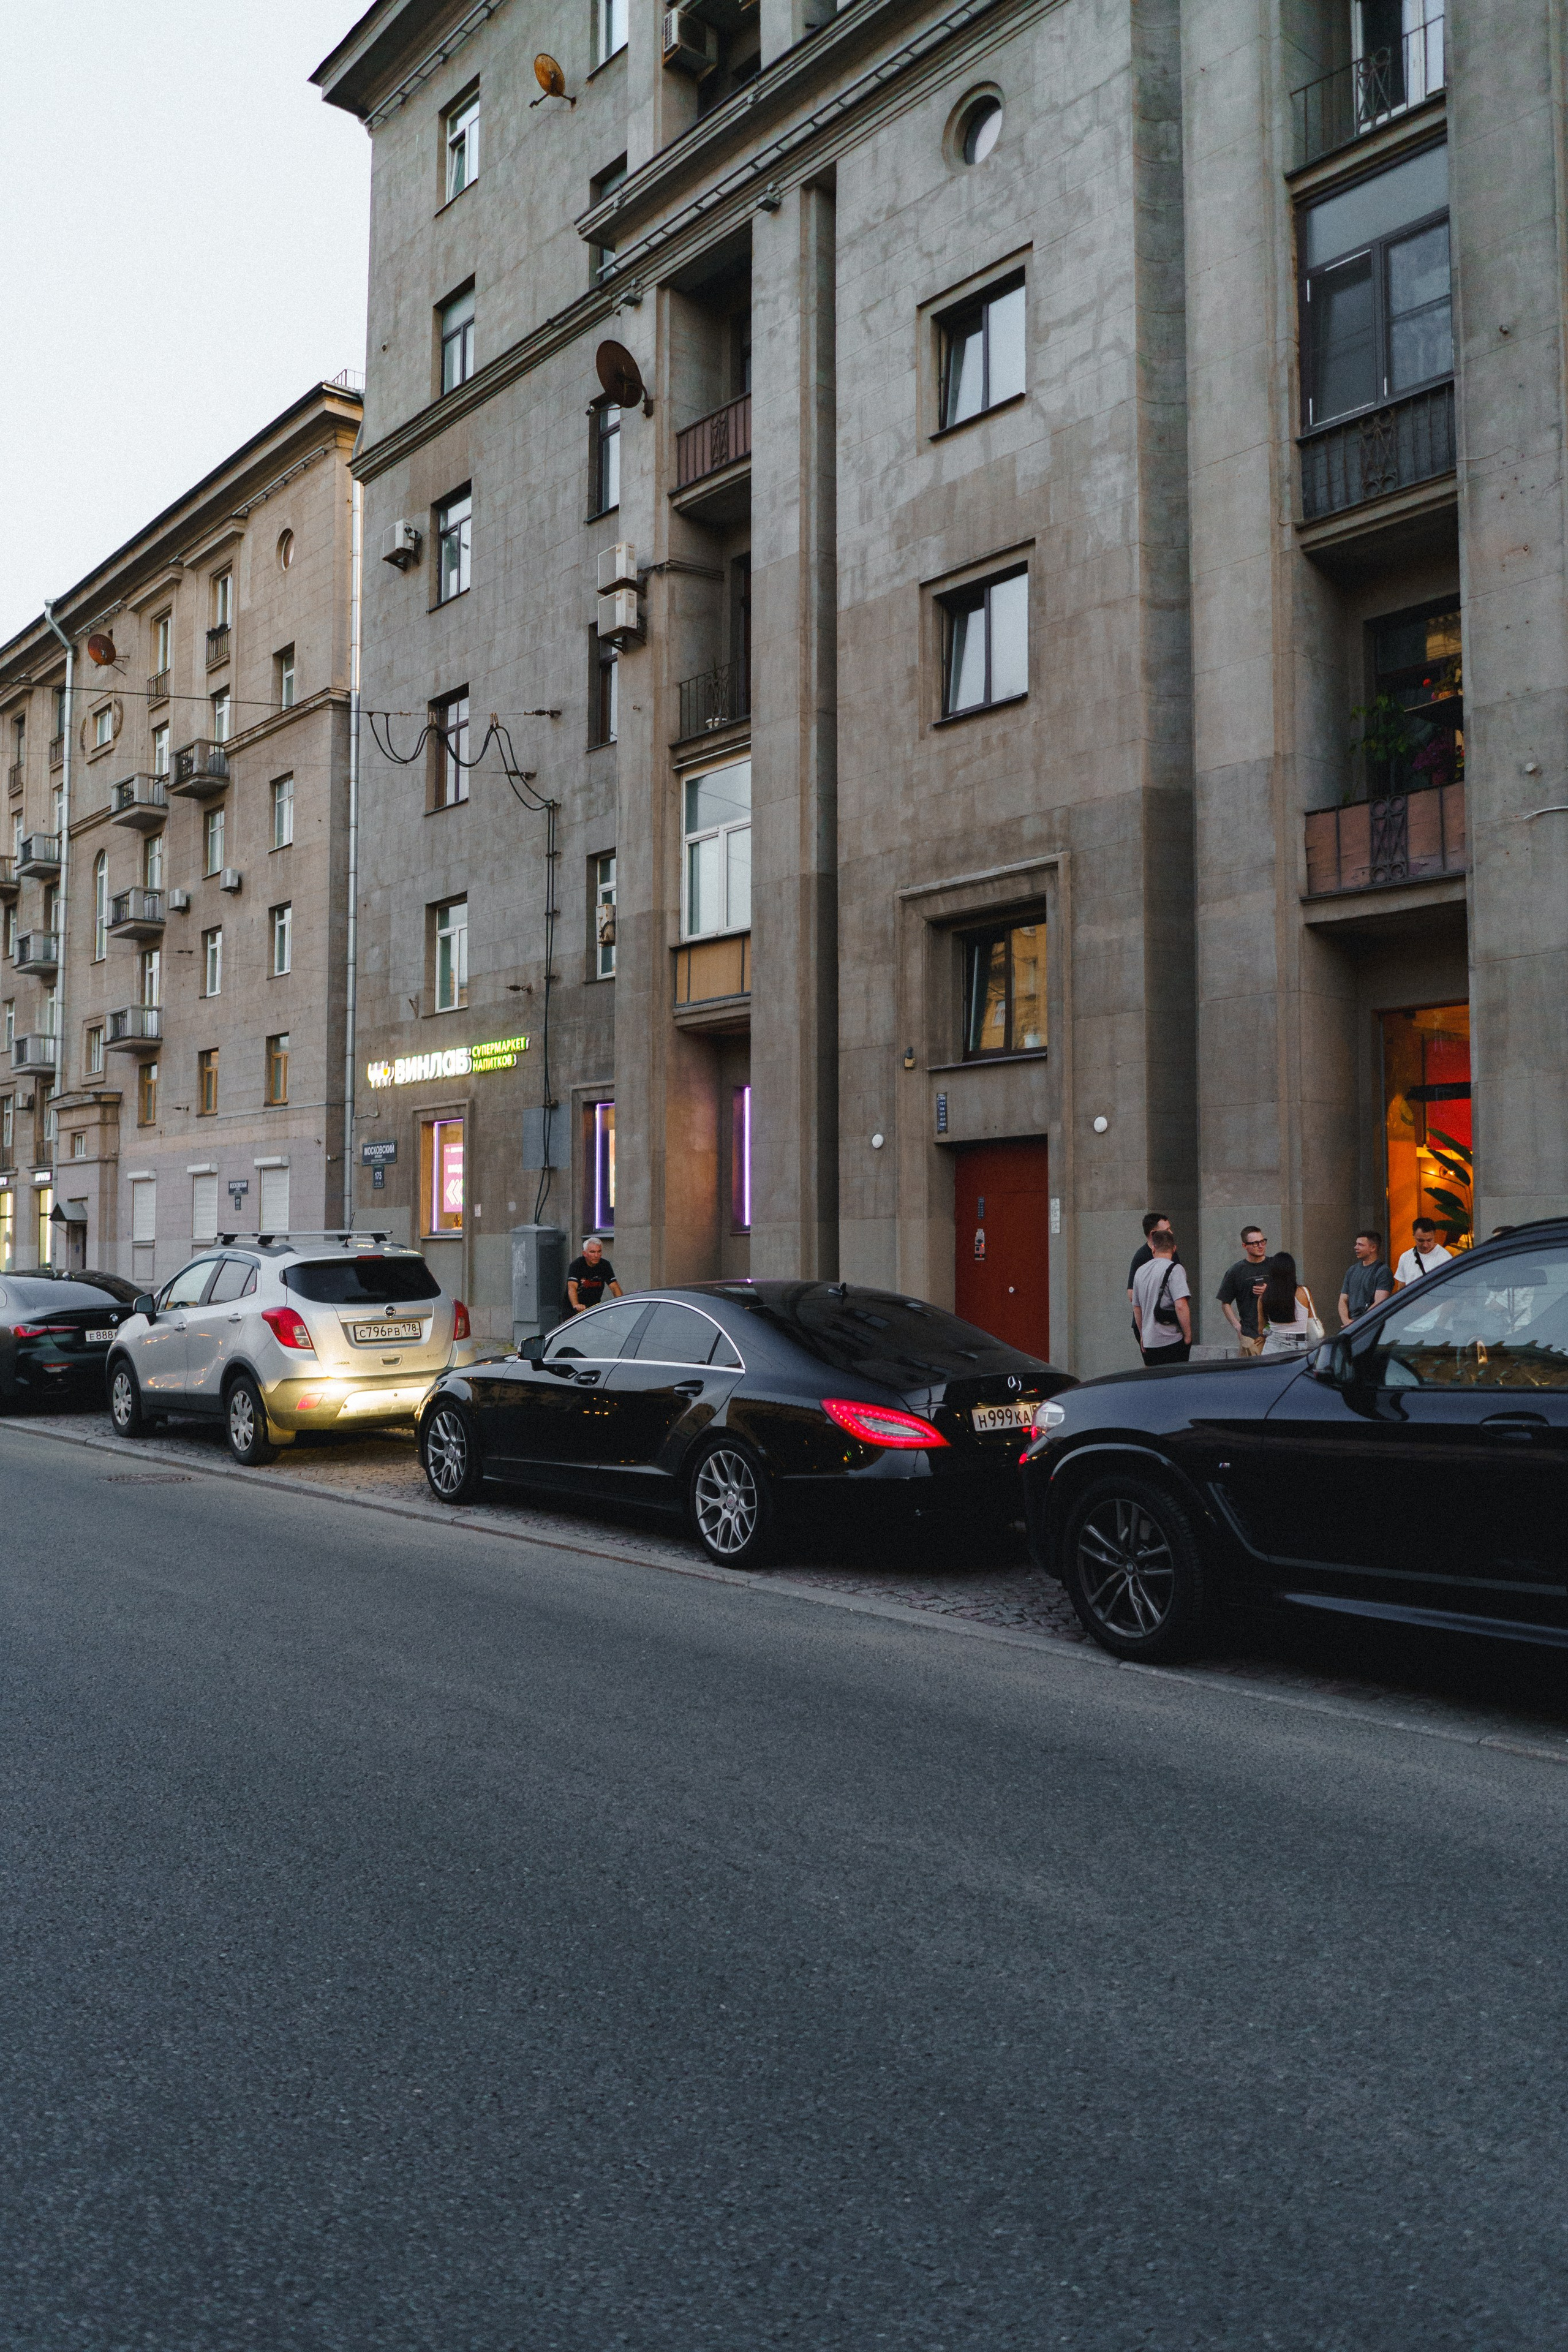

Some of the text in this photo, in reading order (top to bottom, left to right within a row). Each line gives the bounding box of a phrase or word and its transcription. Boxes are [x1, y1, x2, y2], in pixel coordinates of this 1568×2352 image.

[472, 1037, 527, 1057] СУПЕРМАРКЕТ
[472, 1054, 514, 1072] НАПИТКОВ
[364, 1143, 394, 1156] МОСКОВСКИЙ
[402, 1324, 417, 1332] 178
[978, 1408, 1031, 1428] Н999КА
